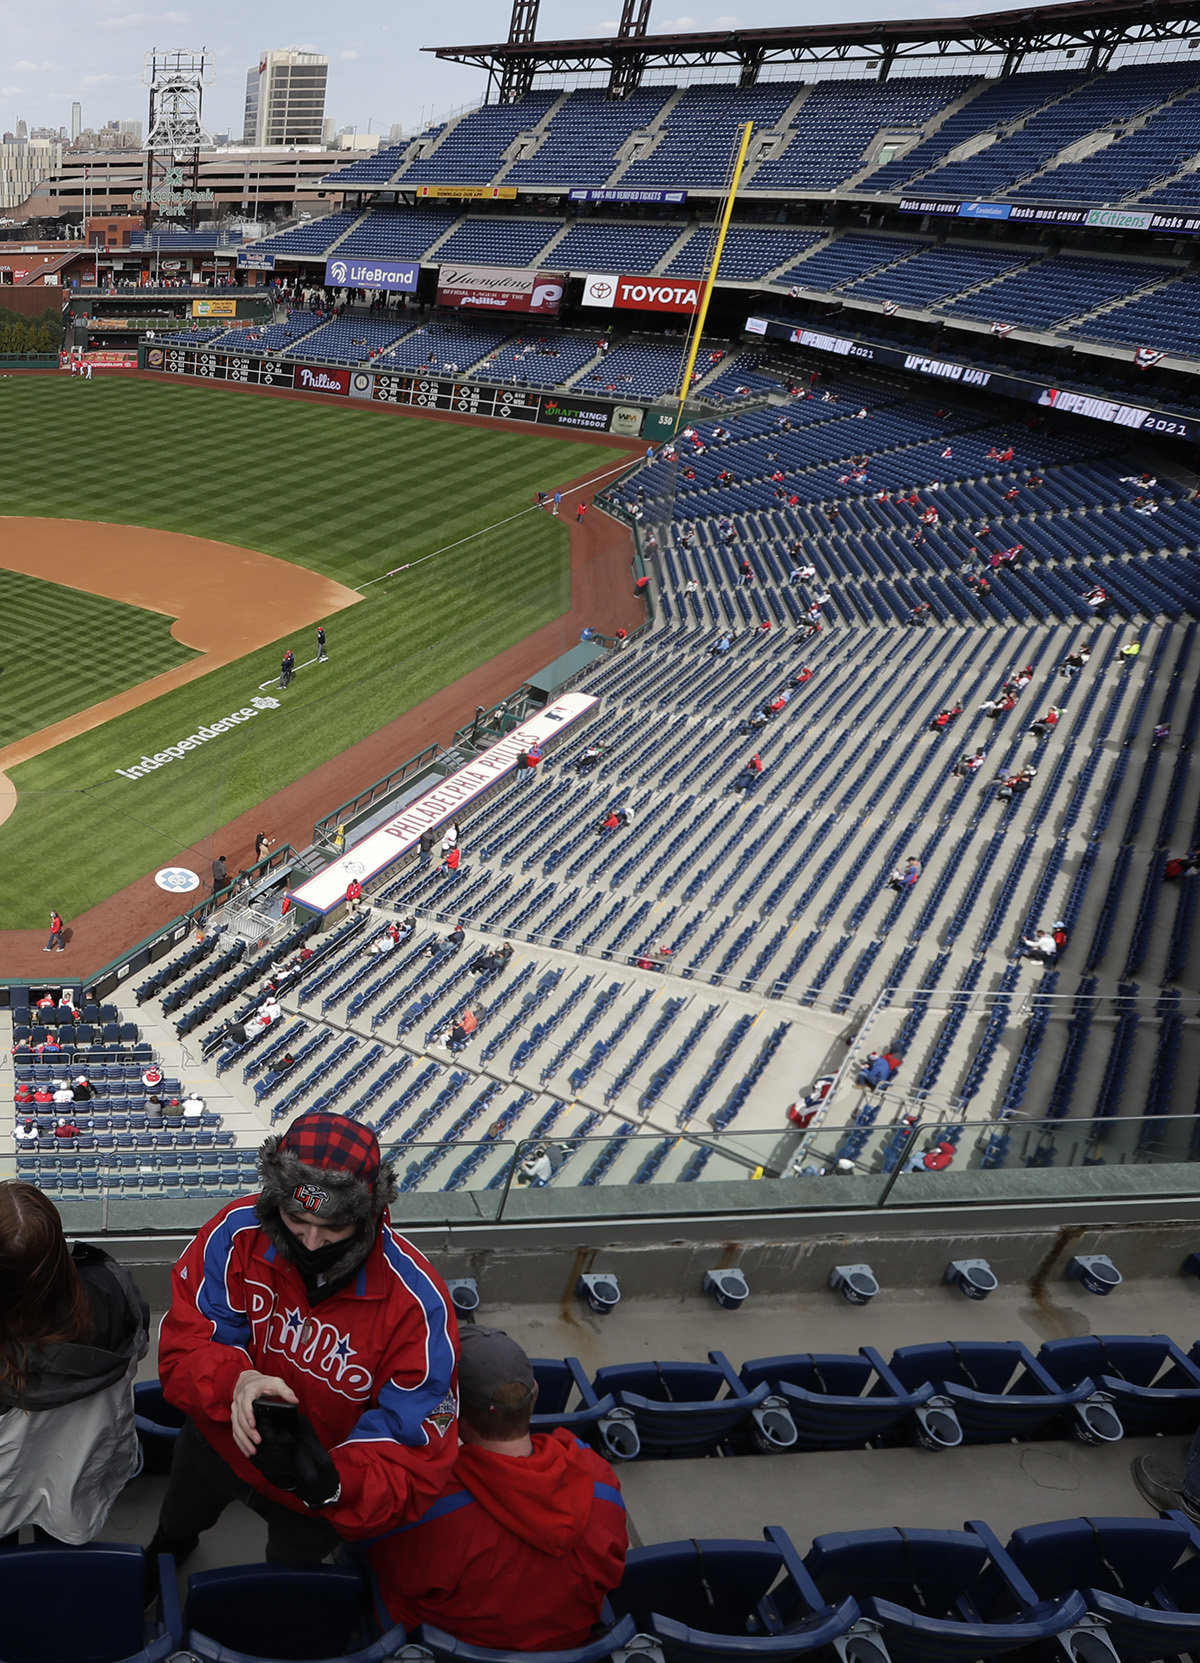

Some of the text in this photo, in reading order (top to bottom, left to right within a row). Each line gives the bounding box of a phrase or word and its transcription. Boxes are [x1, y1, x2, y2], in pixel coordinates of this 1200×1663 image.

[133, 188, 214, 202] Citizens Bank
[591, 190, 605, 199] 100%
[617, 191, 639, 199] VERIFIED
[640, 192, 661, 200] TICKETS
[160, 203, 187, 216] Park
[900, 200, 954, 213] Masks must cover
[1010, 207, 1081, 221] Masks must cover
[1100, 212, 1145, 227] Citizens
[1151, 215, 1183, 229] Masks
[351, 267, 414, 284] LifeBrand
[441, 270, 533, 290] Yuengling
[621, 285, 697, 305] TOYOTA
[802, 331, 874, 359] OPENING DAY 2021
[301, 369, 341, 390] Phillies
[545, 407, 608, 421] DRAFTKINGS
[659, 415, 673, 425] 330
[1055, 391, 1187, 436] OPENING DAY 2021
[559, 416, 606, 428] SPORTSBOOK
[115, 707, 258, 780] Independence
[384, 731, 540, 841] PHILADELPHIA PHILLIES
[244, 1278, 374, 1401] Phillie
